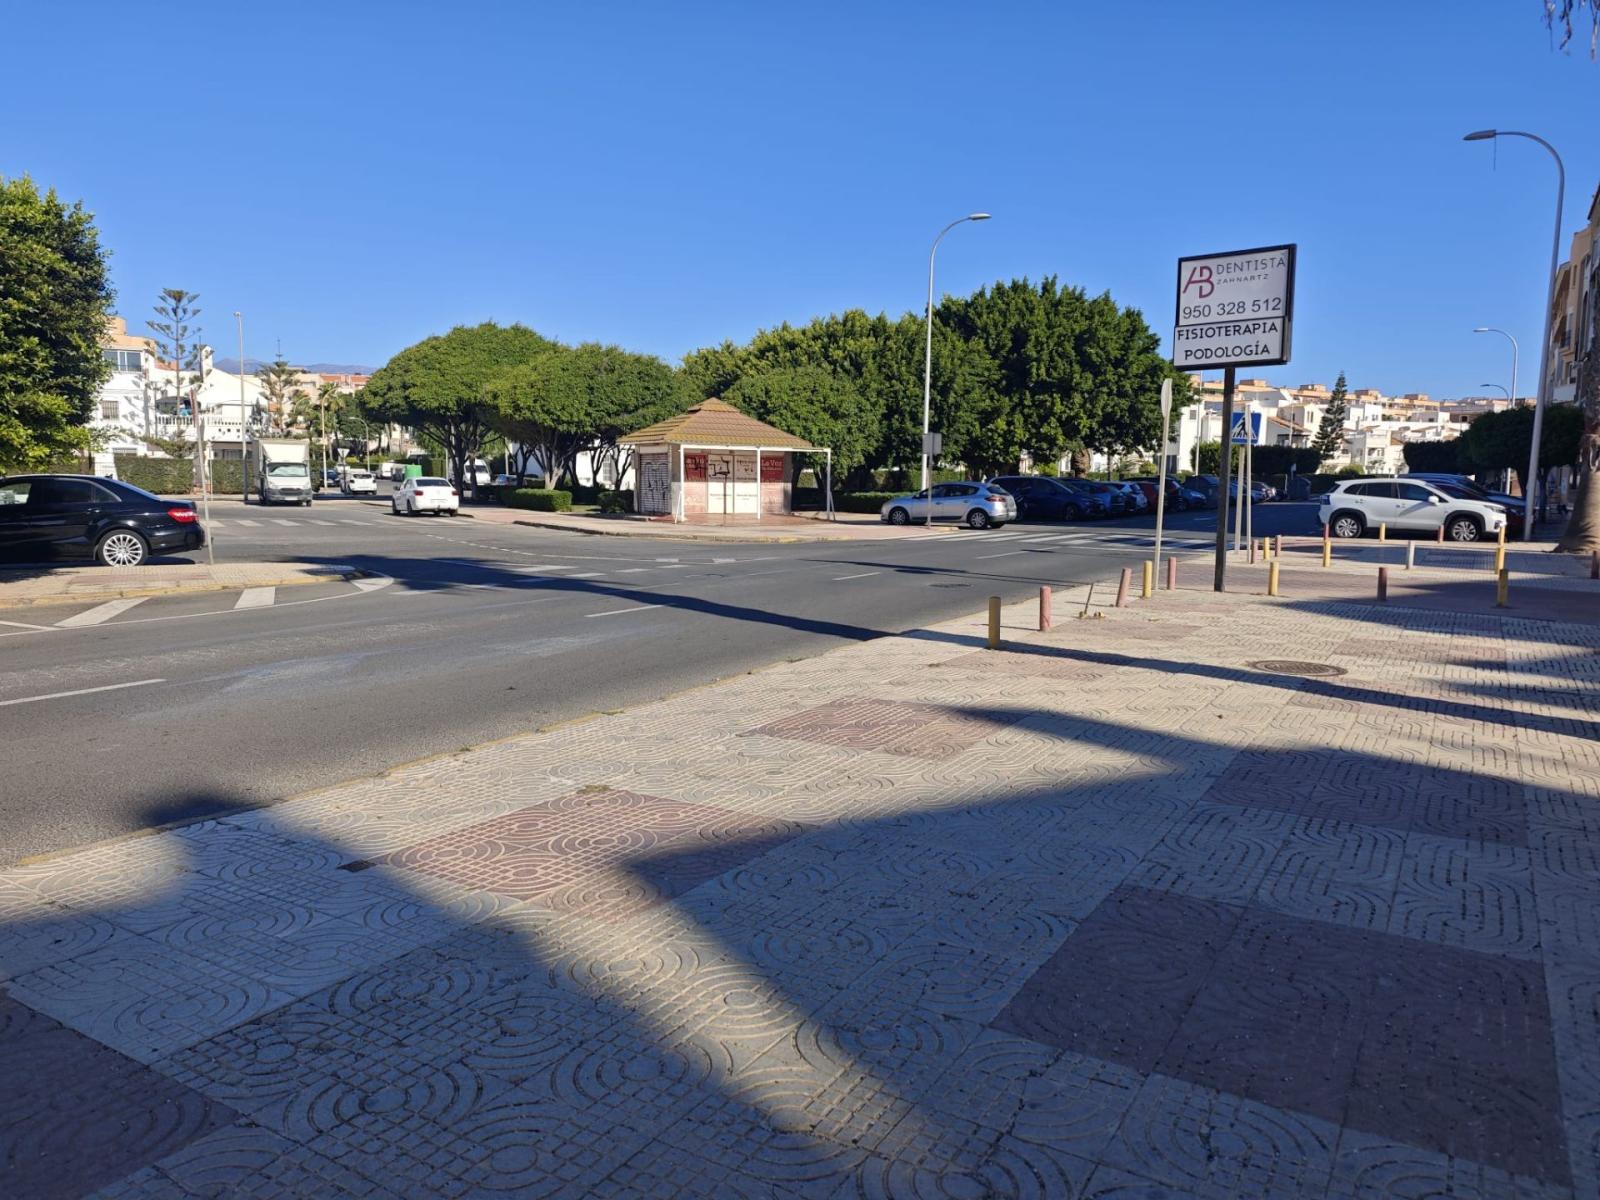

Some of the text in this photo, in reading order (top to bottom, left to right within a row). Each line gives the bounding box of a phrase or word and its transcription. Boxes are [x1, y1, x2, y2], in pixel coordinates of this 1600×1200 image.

[1216, 257, 1286, 275] DENTISTA
[1183, 297, 1282, 320] 950 328 512
[1177, 322, 1278, 341] FISIOTERAPIA
[1184, 341, 1270, 360] PODOLOGÍA
